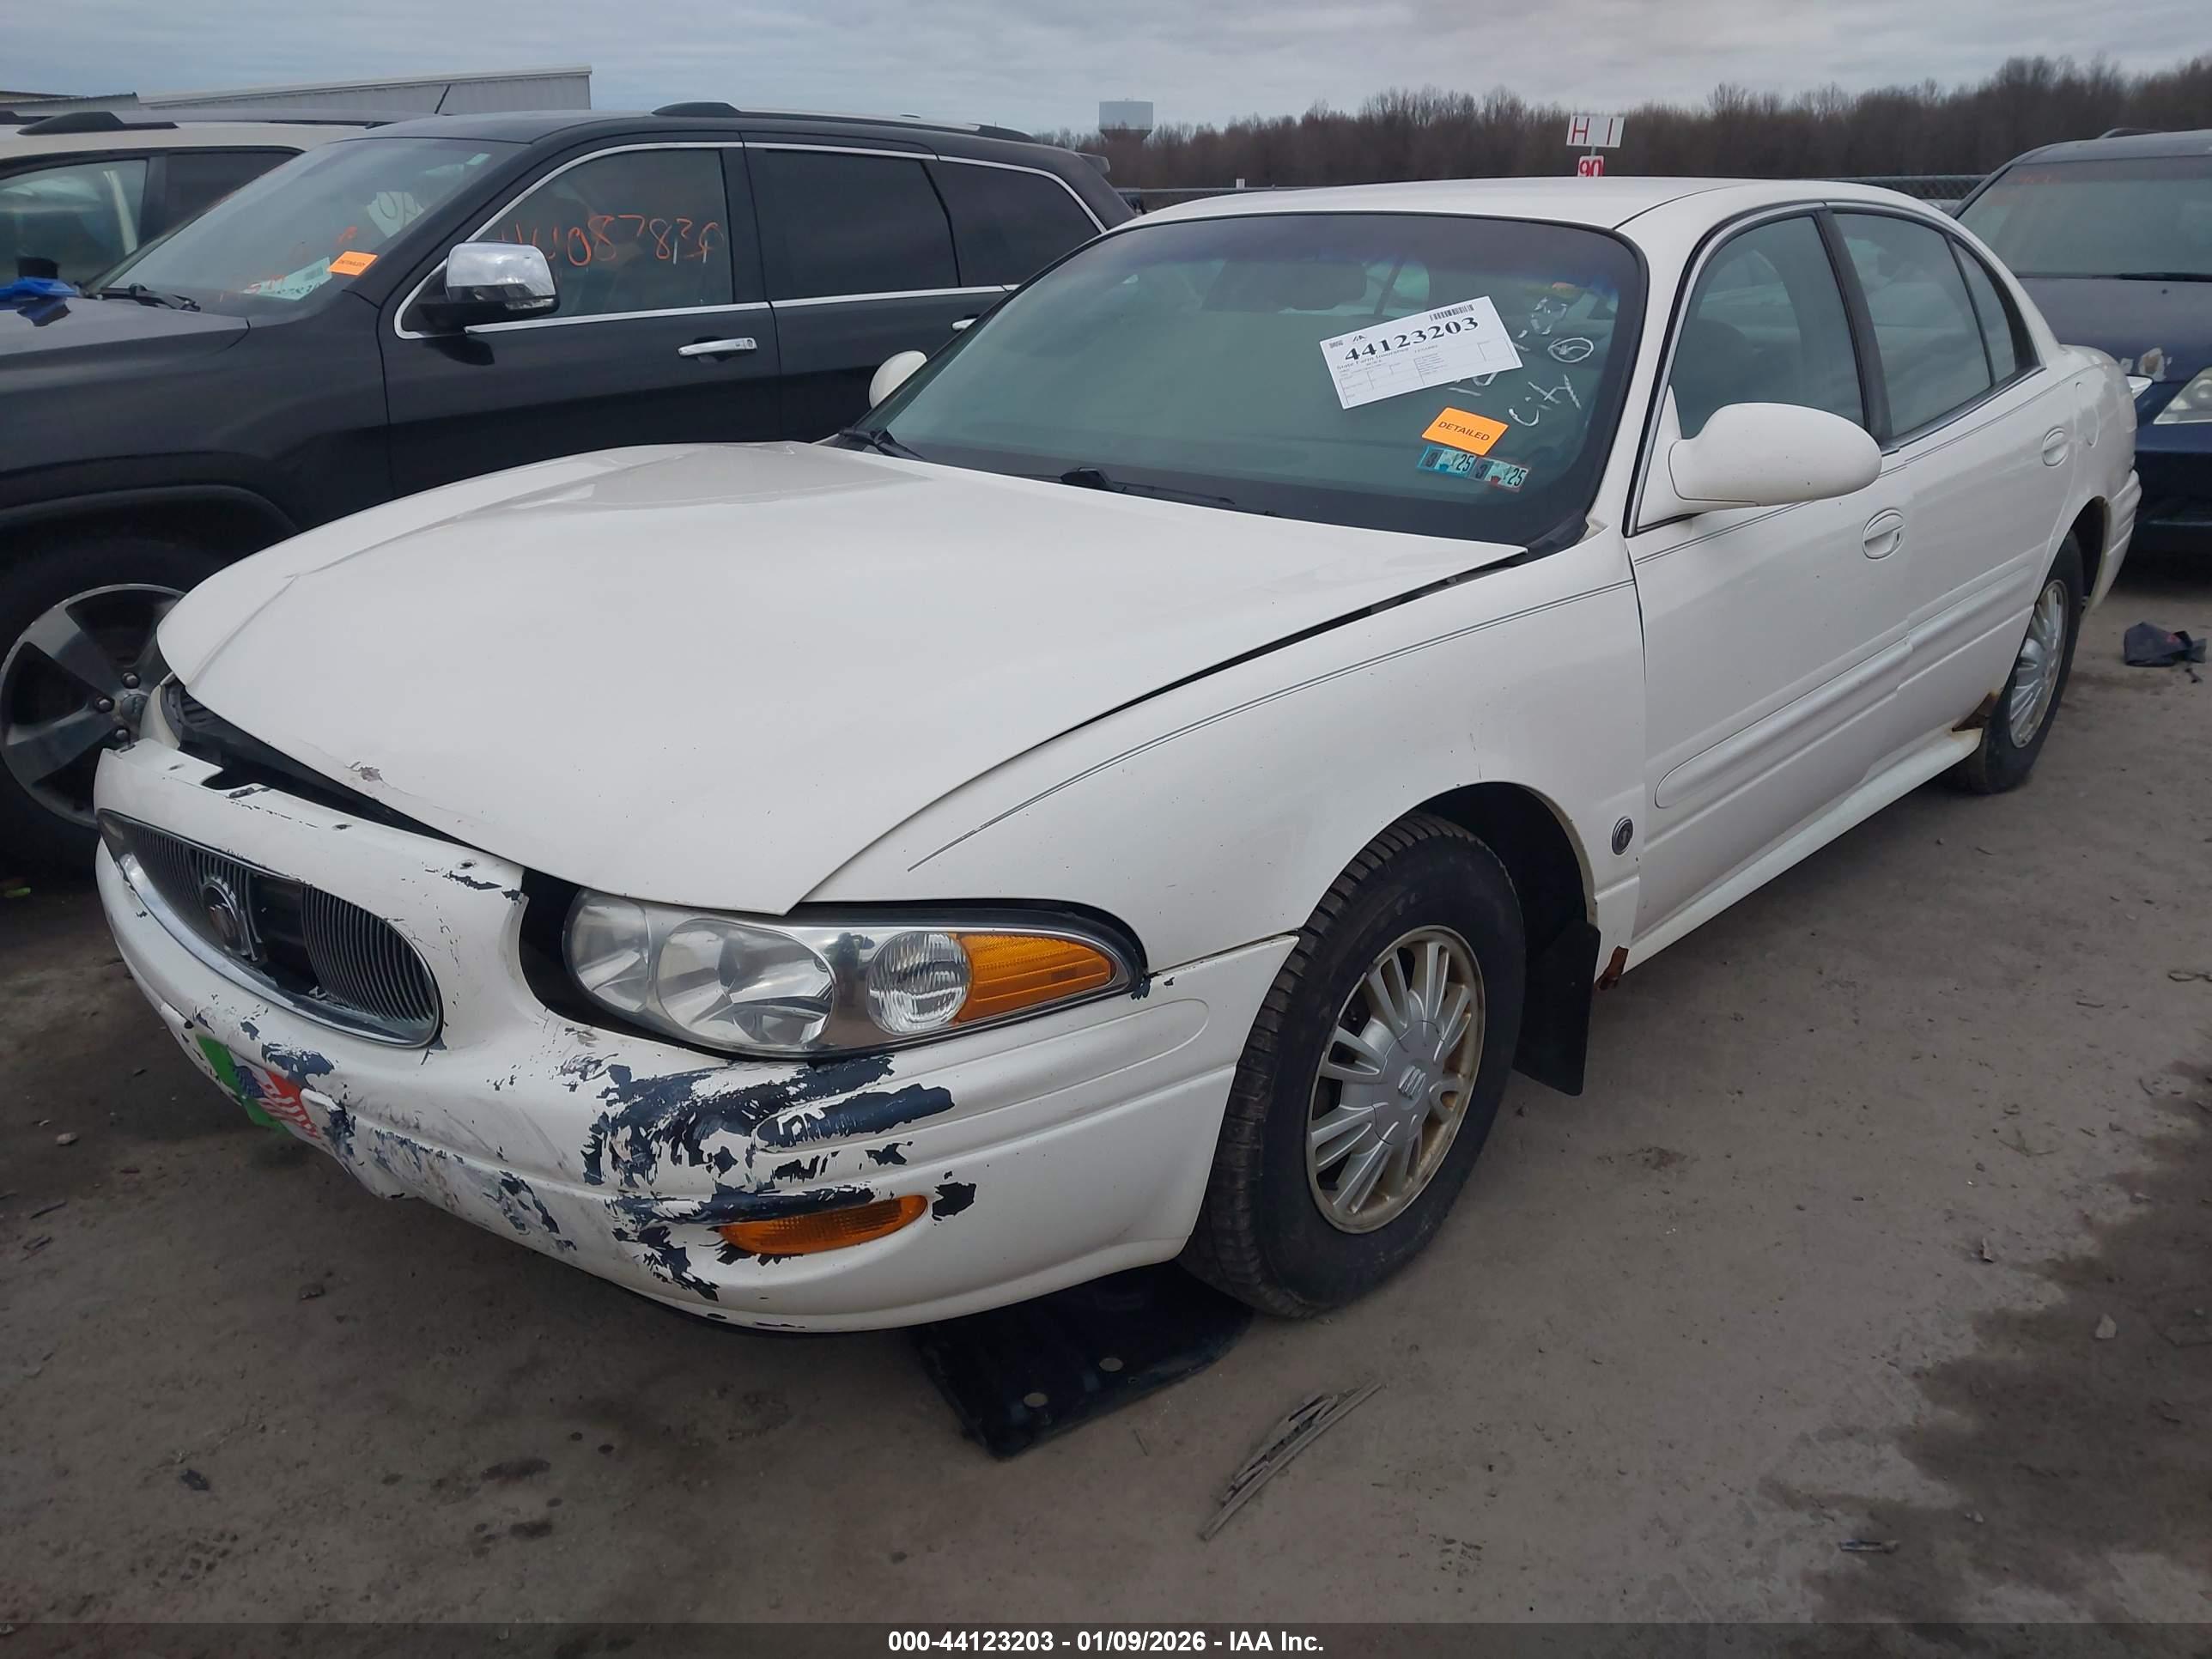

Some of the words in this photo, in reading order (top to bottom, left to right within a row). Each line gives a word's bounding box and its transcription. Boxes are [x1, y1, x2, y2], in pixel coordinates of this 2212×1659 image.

[1571, 116, 1590, 144] H
[1579, 159, 1603, 177] 90
[1345, 317, 1479, 362] 44123203
[1438, 421, 1491, 441] DETAILED
[1455, 453, 1474, 472] 25
[1474, 464, 1488, 479] 3
[1507, 467, 1527, 487] 25
